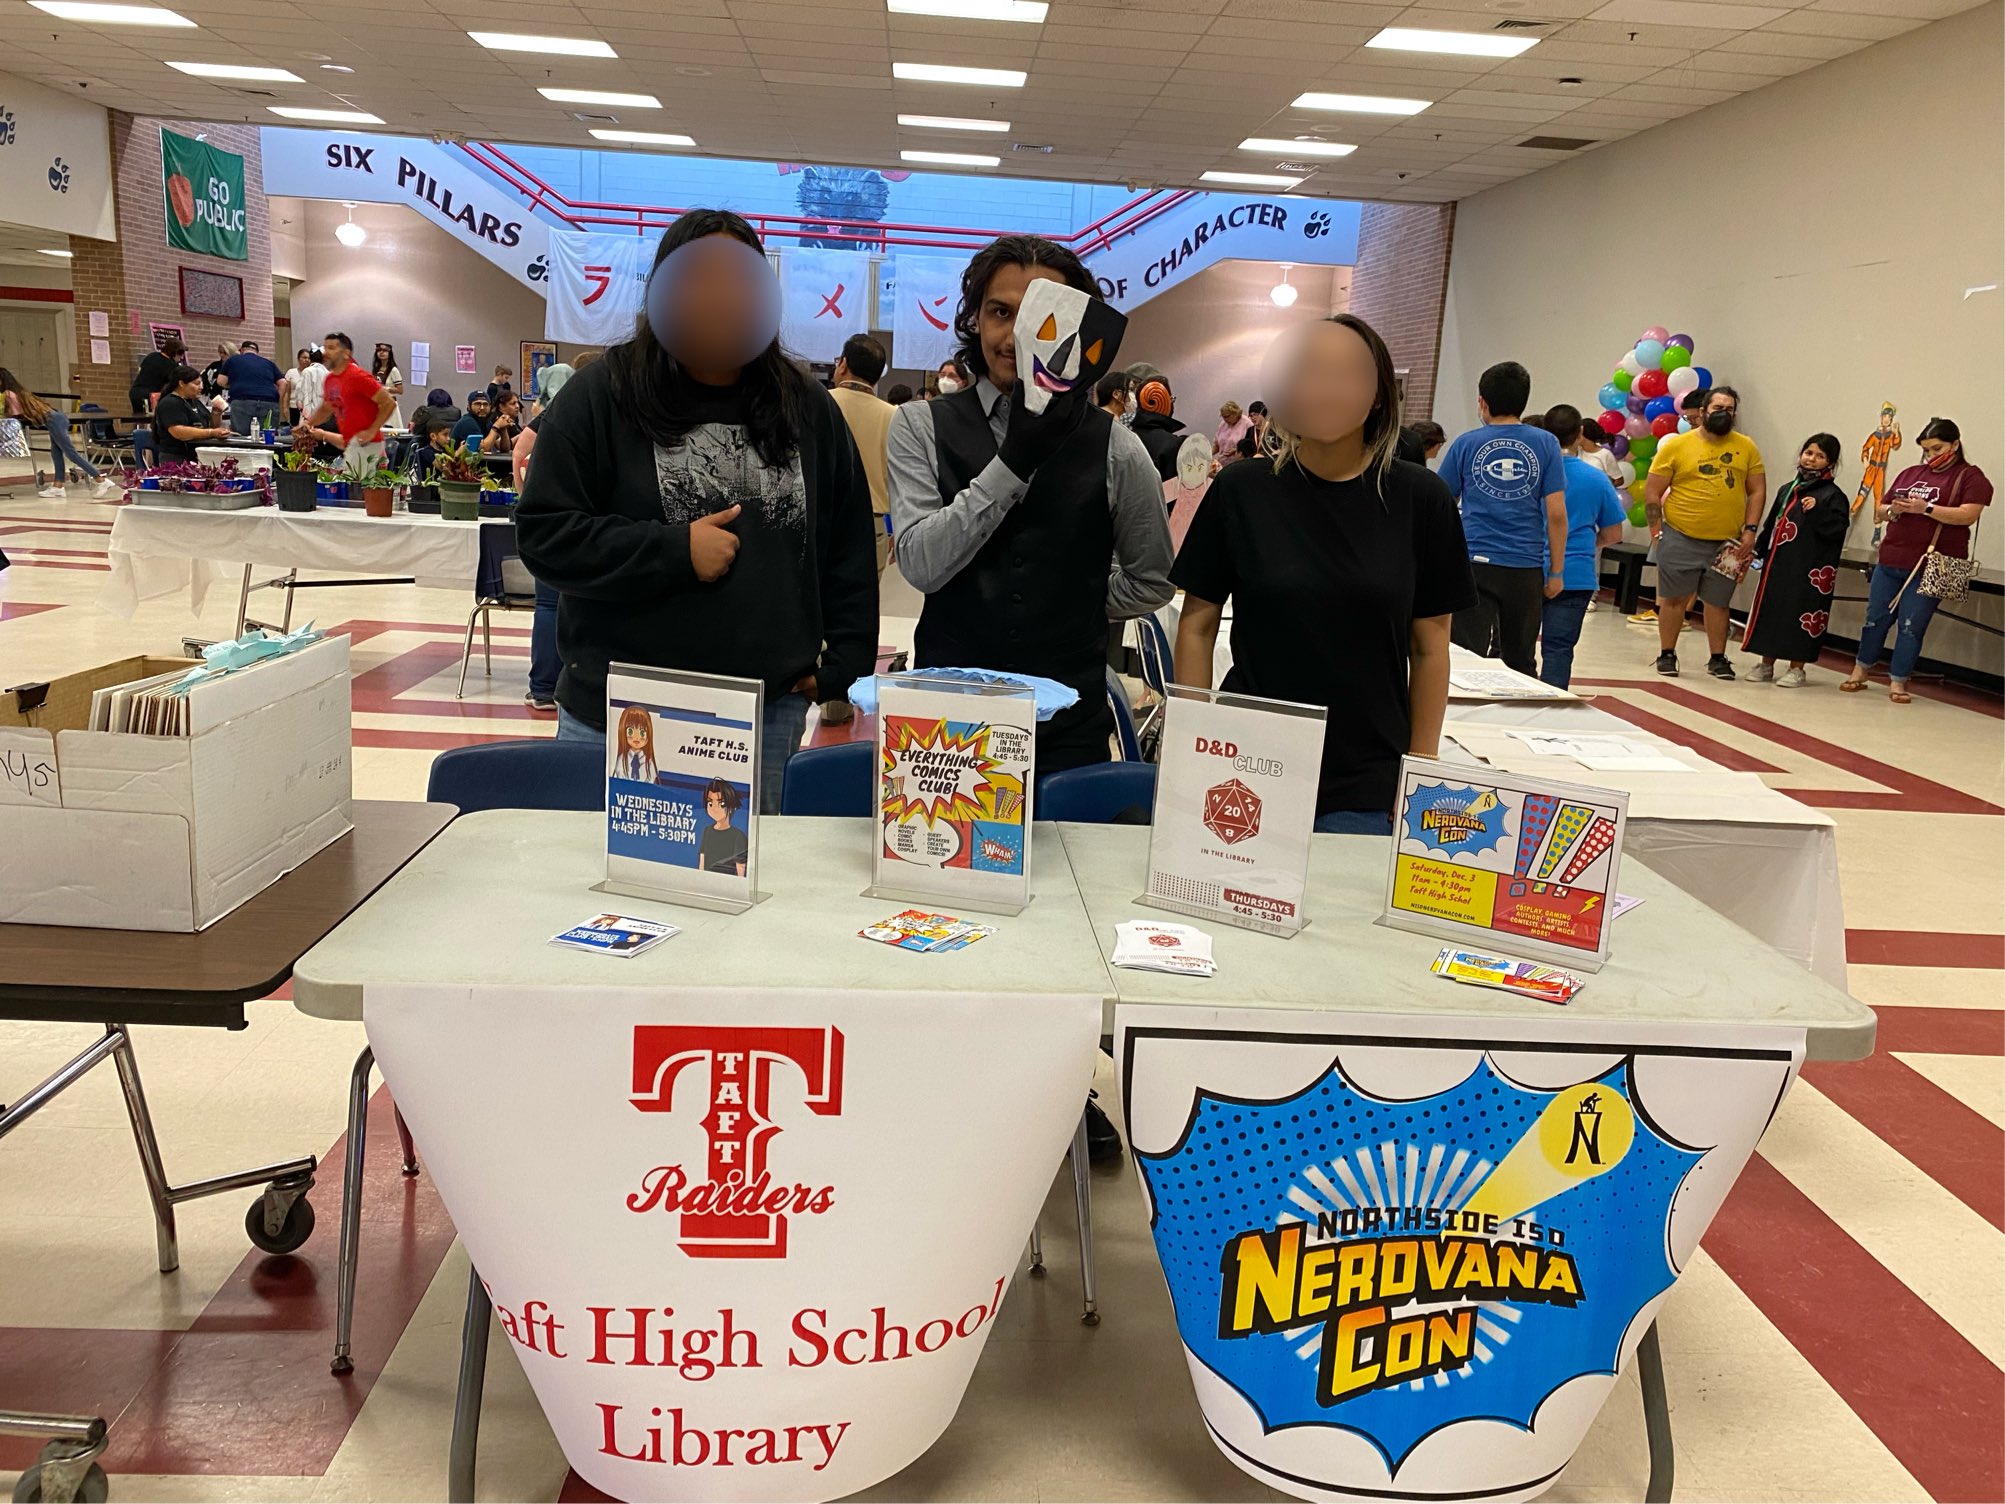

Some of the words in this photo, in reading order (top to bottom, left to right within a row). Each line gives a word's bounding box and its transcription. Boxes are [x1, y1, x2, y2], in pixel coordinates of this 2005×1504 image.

[208, 177, 229, 202] GO
[326, 143, 374, 173] SIX
[398, 155, 522, 247] PILLARS
[196, 199, 245, 232] PUBLIC
[1097, 276, 1127, 299] OF
[1144, 203, 1288, 287] CHARACTER
[582, 266, 611, 306] ラ
[1476, 446, 1491, 464] YOUR
[1515, 442, 1538, 477] CHAMPION
[1475, 465, 1481, 475] BE
[1480, 482, 1511, 499] SINCE
[694, 735, 723, 748] TAFT
[725, 739, 749, 752] H.S.
[992, 731, 1029, 742] TUESDAYS
[1000, 739, 1007, 747] IN
[1009, 740, 1022, 748] THE
[678, 745, 715, 759] ANIME
[718, 751, 749, 764] CLUB
[992, 752, 1008, 761] 4:45
[1013, 754, 1029, 763] 5:30
[996, 745, 1026, 755] LIBRARY
[1195, 737, 1238, 759] D&D
[900, 749, 978, 770] EVERYTHING
[1233, 755, 1283, 777] CLUB
[911, 765, 961, 782] COMICS
[918, 779, 958, 795] CLUB!
[615, 792, 693, 818] WEDNESDAYS
[1212, 794, 1222, 803] 2
[1245, 797, 1255, 812] 14
[611, 805, 622, 819] IN
[625, 807, 647, 824] THE
[649, 811, 697, 831] LIBRARY
[1224, 805, 1241, 818] 20
[1423, 810, 1487, 832] NERDVANA
[612, 821, 649, 838] 4:45PM
[658, 826, 696, 845] 5:30PM
[1225, 828, 1234, 837] 8
[1439, 827, 1467, 844] CON
[984, 842, 1015, 861] WHAM!
[1211, 850, 1223, 858] THE
[1226, 852, 1255, 865] LIBRARY
[1411, 874, 1430, 884] 11am
[1440, 880, 1471, 893] 4:30pm
[1452, 870, 1467, 881] Dec.
[1469, 874, 1476, 882] 3
[1410, 885, 1427, 895] Taft
[1428, 889, 1446, 901] High
[1230, 893, 1290, 914] THURSDAYS
[1233, 905, 1253, 916] 4:45
[1261, 911, 1282, 923] 5:30
[1541, 923, 1555, 931] AND
[1556, 927, 1576, 936] MUCH
[714, 1051, 744, 1165] TAFT
[1563, 1110, 1604, 1165] N
[626, 1164, 835, 1218] Raiders
[1317, 1206, 1499, 1241] NORTHSIDE
[1511, 1217, 1565, 1248] ISD
[1228, 1225, 1581, 1334] NERDVANA
[481, 1279, 568, 1359] aft
[586, 1306, 763, 1382] High
[788, 1275, 1006, 1368] School
[1328, 1305, 1474, 1398] CON
[594, 1402, 852, 1471] Library
